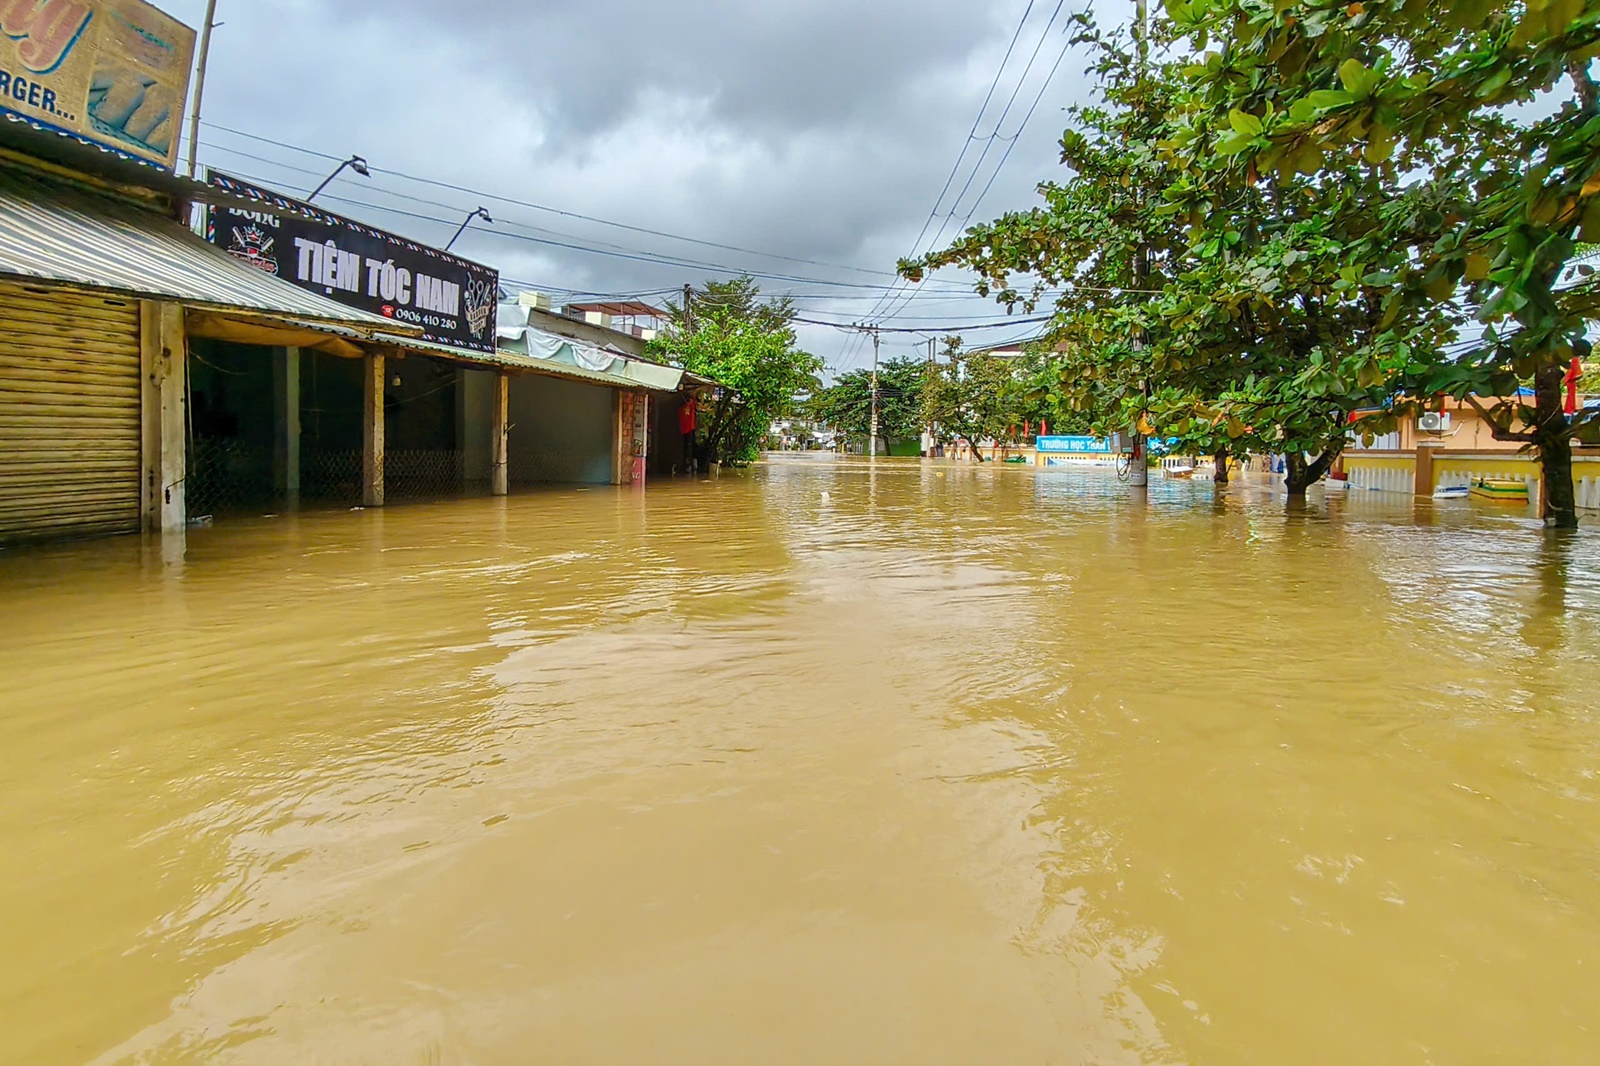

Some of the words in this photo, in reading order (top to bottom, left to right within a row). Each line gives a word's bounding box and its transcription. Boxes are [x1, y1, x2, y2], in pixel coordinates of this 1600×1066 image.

[294, 236, 360, 294] TIỆM
[365, 258, 411, 305] TÓC
[415, 272, 460, 317] NAM
[395, 308, 421, 323] 0906
[422, 314, 440, 326] 410
[440, 318, 457, 330] 280
